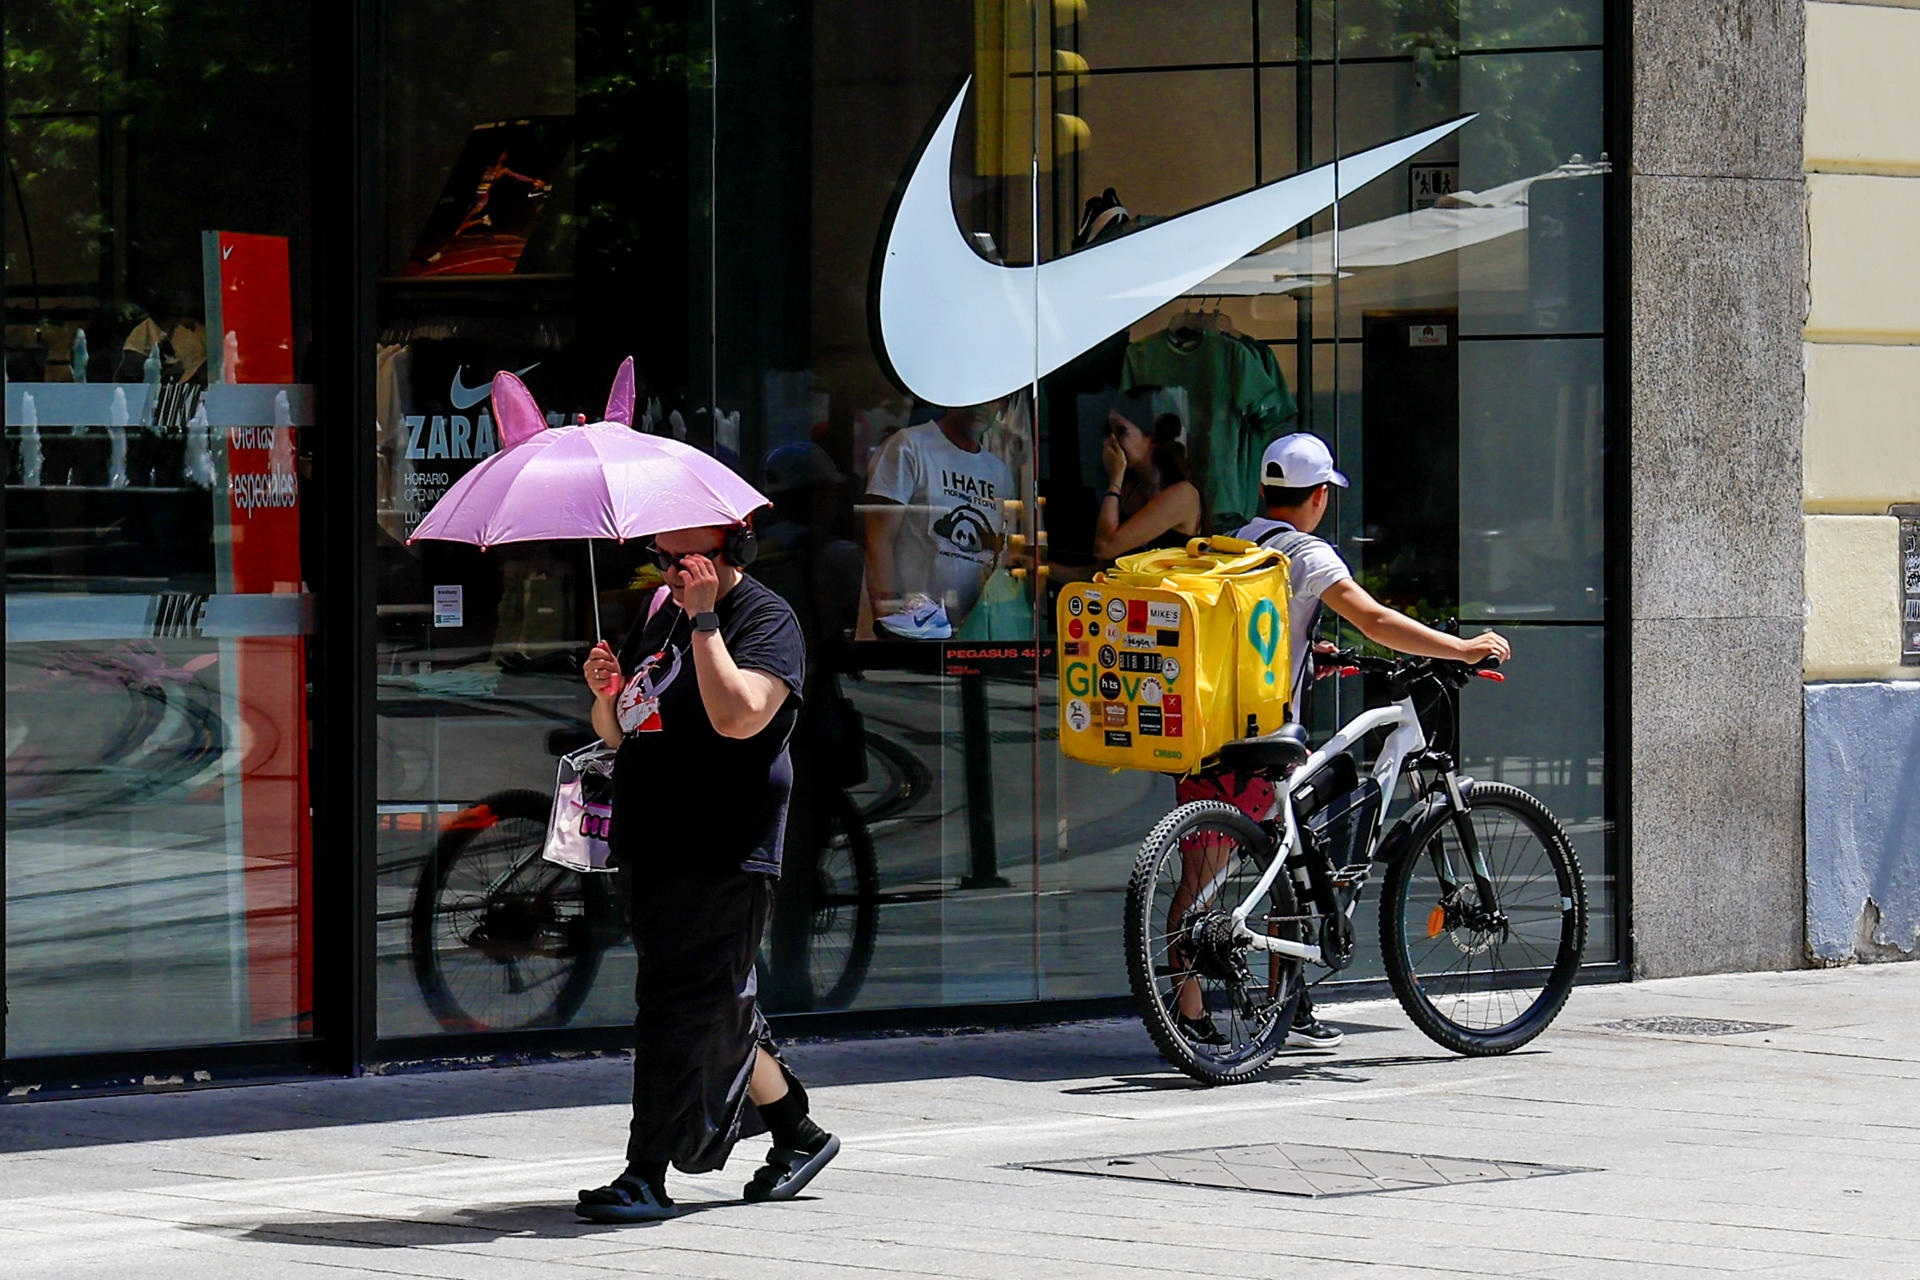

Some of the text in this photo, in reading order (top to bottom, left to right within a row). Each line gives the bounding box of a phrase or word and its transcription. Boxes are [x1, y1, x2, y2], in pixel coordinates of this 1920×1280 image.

[404, 472, 449, 486] HORARIO
[942, 469, 995, 500] I HATE
[234, 463, 296, 519] especiales
[149, 594, 209, 638] NIKE
[1150, 608, 1179, 620] MIKE'S
[946, 648, 1018, 659] PEGASUS
